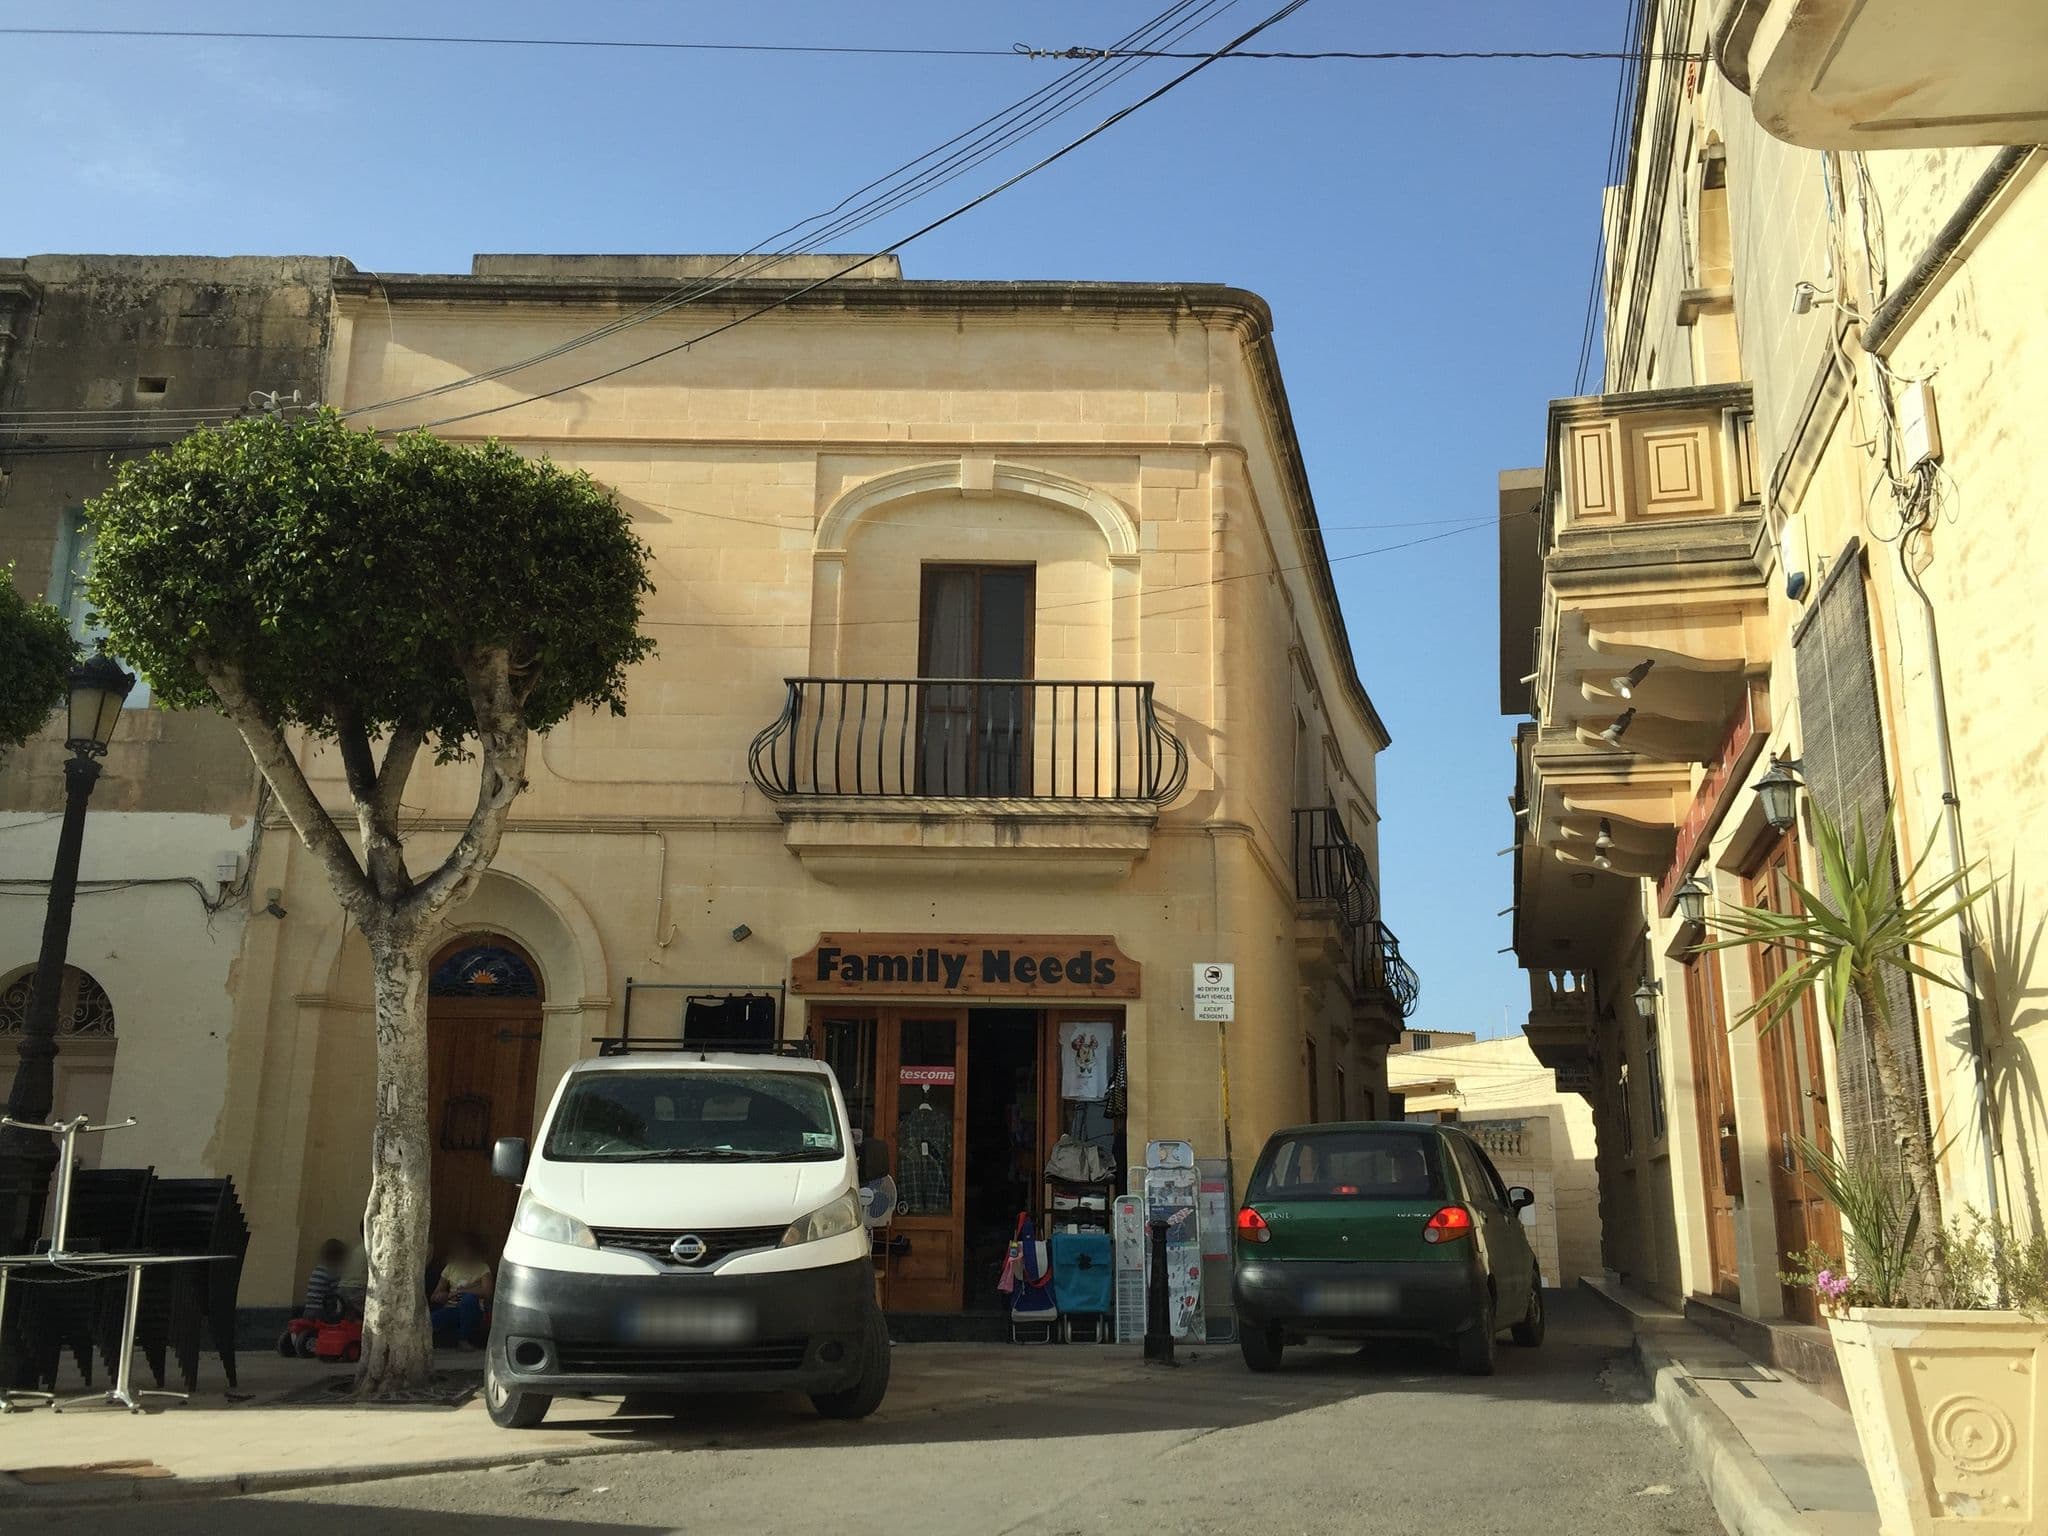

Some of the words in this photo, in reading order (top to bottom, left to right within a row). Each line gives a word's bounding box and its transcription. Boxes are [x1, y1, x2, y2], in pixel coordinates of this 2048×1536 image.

[816, 947, 968, 989] Family
[982, 949, 1116, 985] Needs
[899, 1068, 955, 1080] tescoma
